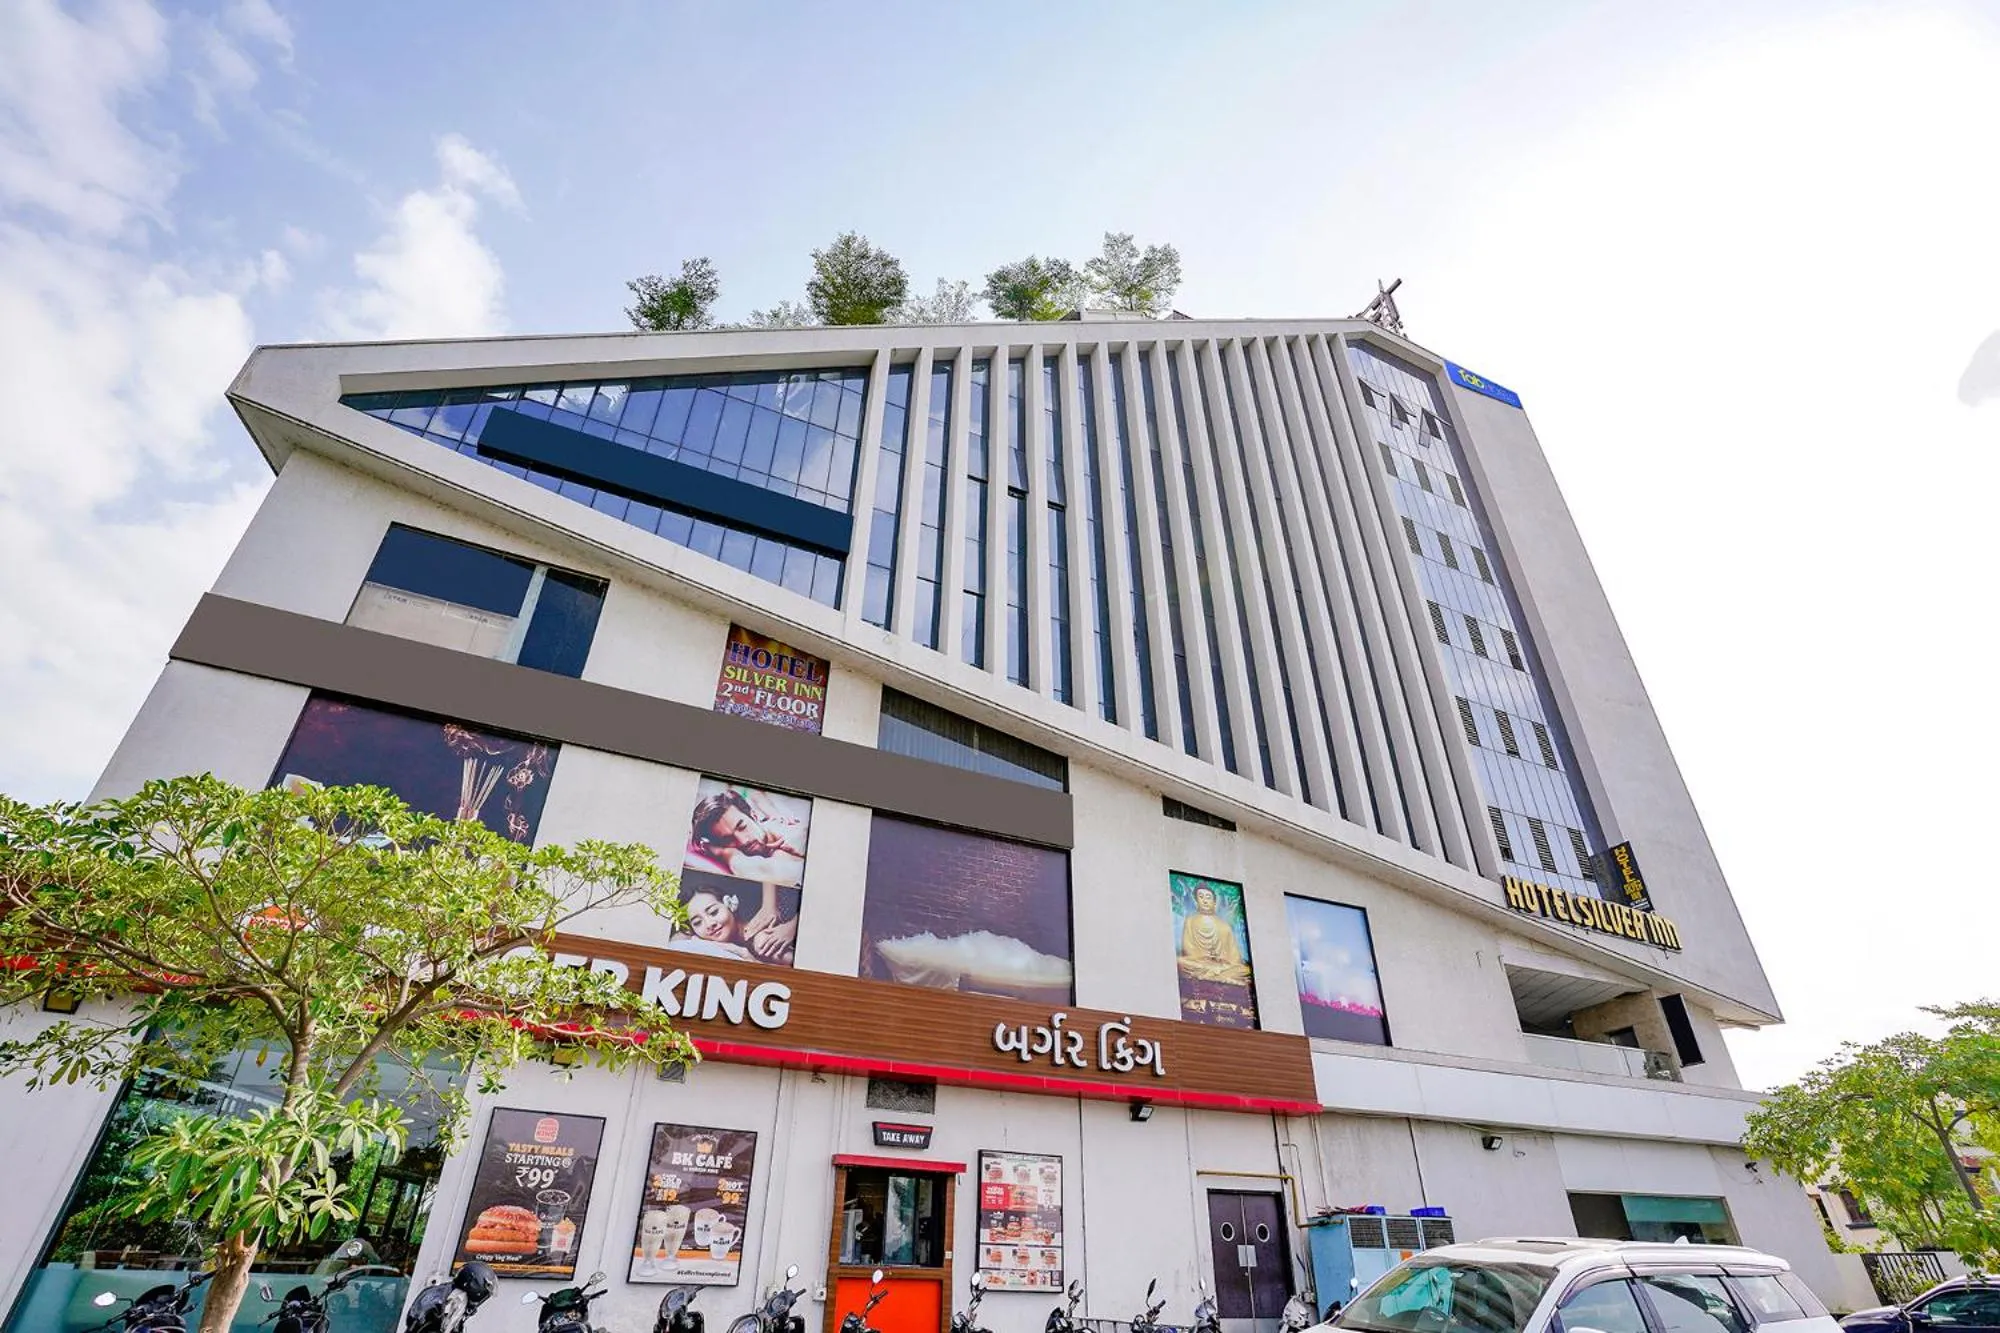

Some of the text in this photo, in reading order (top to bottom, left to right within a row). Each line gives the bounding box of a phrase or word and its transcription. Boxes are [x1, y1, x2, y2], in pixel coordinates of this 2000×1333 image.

[729, 641, 824, 684] HOTEL
[719, 682, 749, 698] 2nd
[754, 688, 819, 719] FLOOR
[723, 665, 824, 701] SILVER INN
[640, 965, 792, 1030] KING
[994, 1012, 1167, 1077] બર્ગર કિંગ
[508, 1143, 541, 1154] TASTY
[882, 1131, 925, 1145] TAKE AWAY
[671, 1151, 733, 1170] BK CAFÉ
